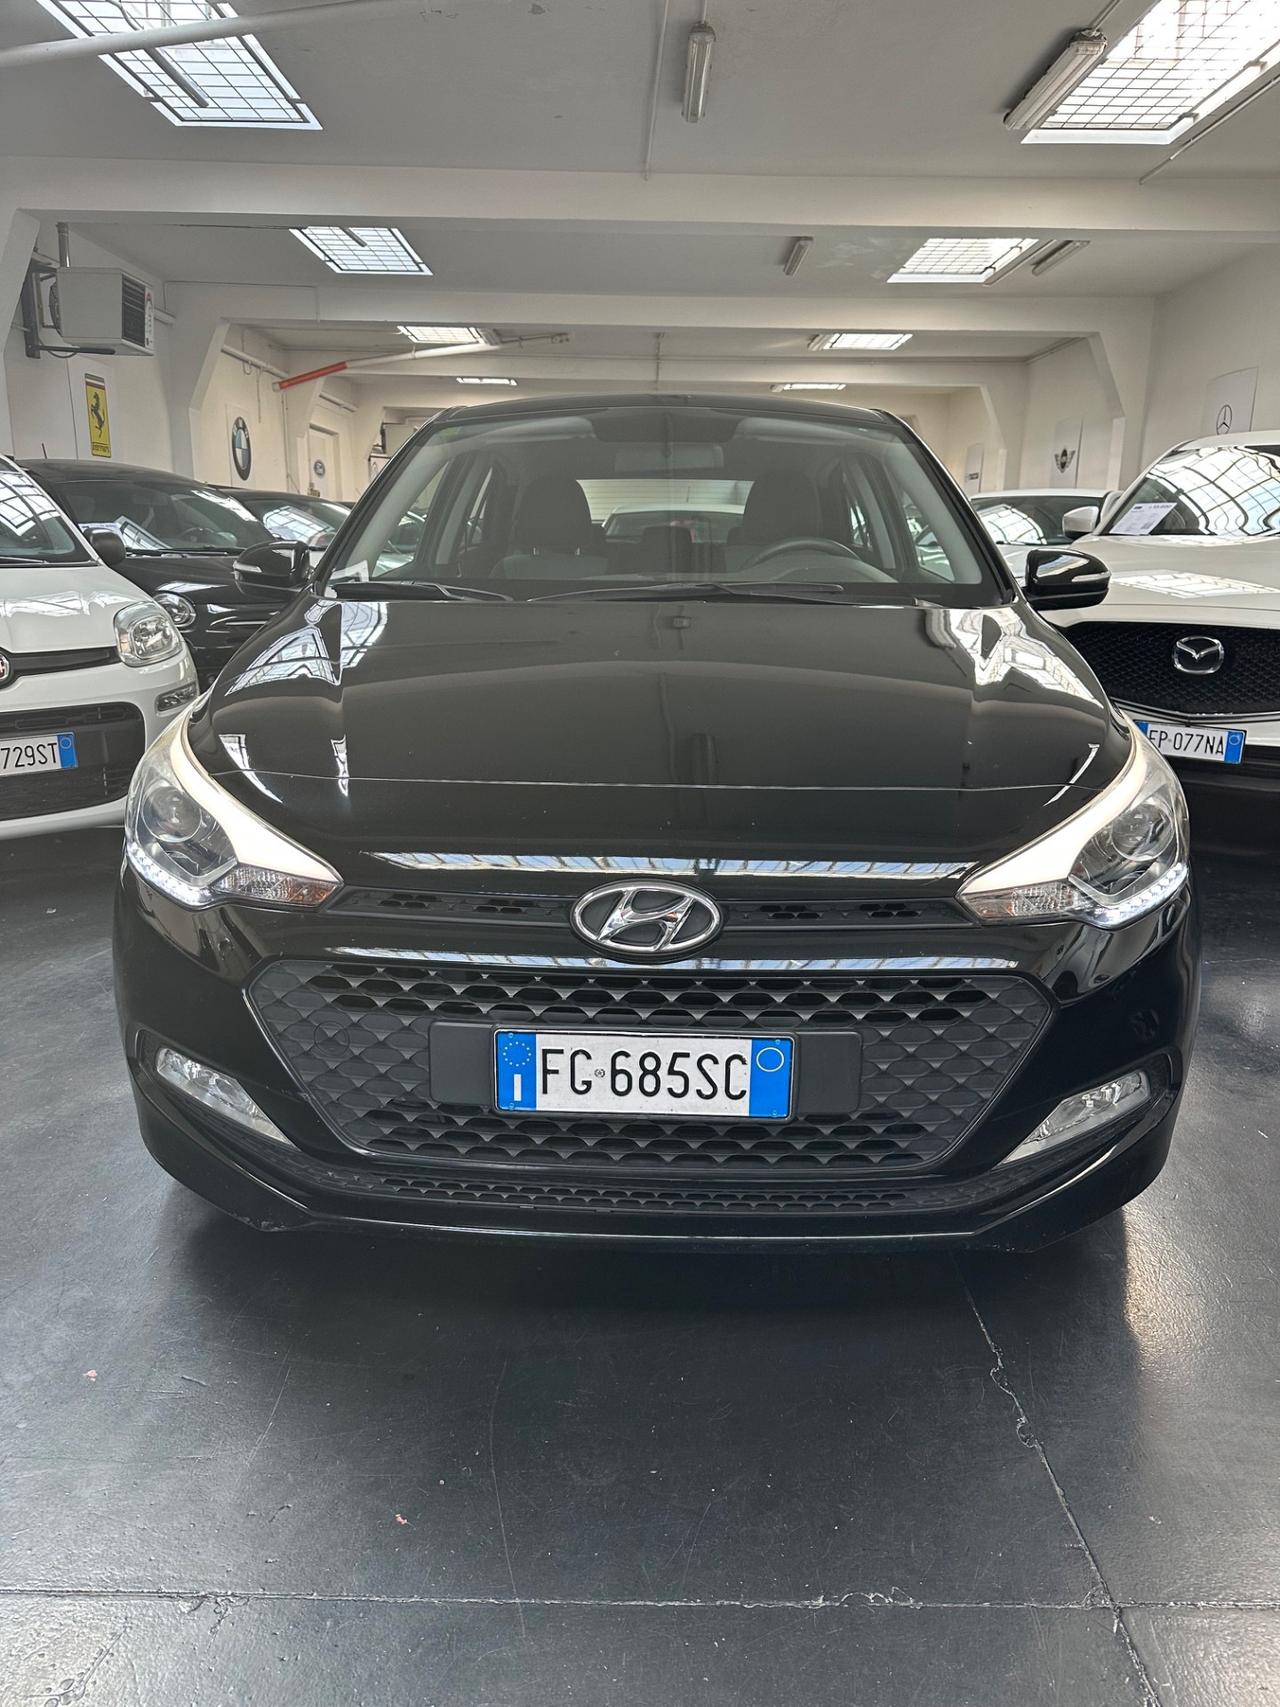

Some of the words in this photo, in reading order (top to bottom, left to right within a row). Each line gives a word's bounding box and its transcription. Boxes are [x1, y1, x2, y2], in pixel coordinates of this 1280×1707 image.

[0, 742, 57, 769] 729ST
[1173, 732, 1224, 756] 077NA
[541, 1048, 593, 1095] FG
[610, 1050, 748, 1101] 685SC
